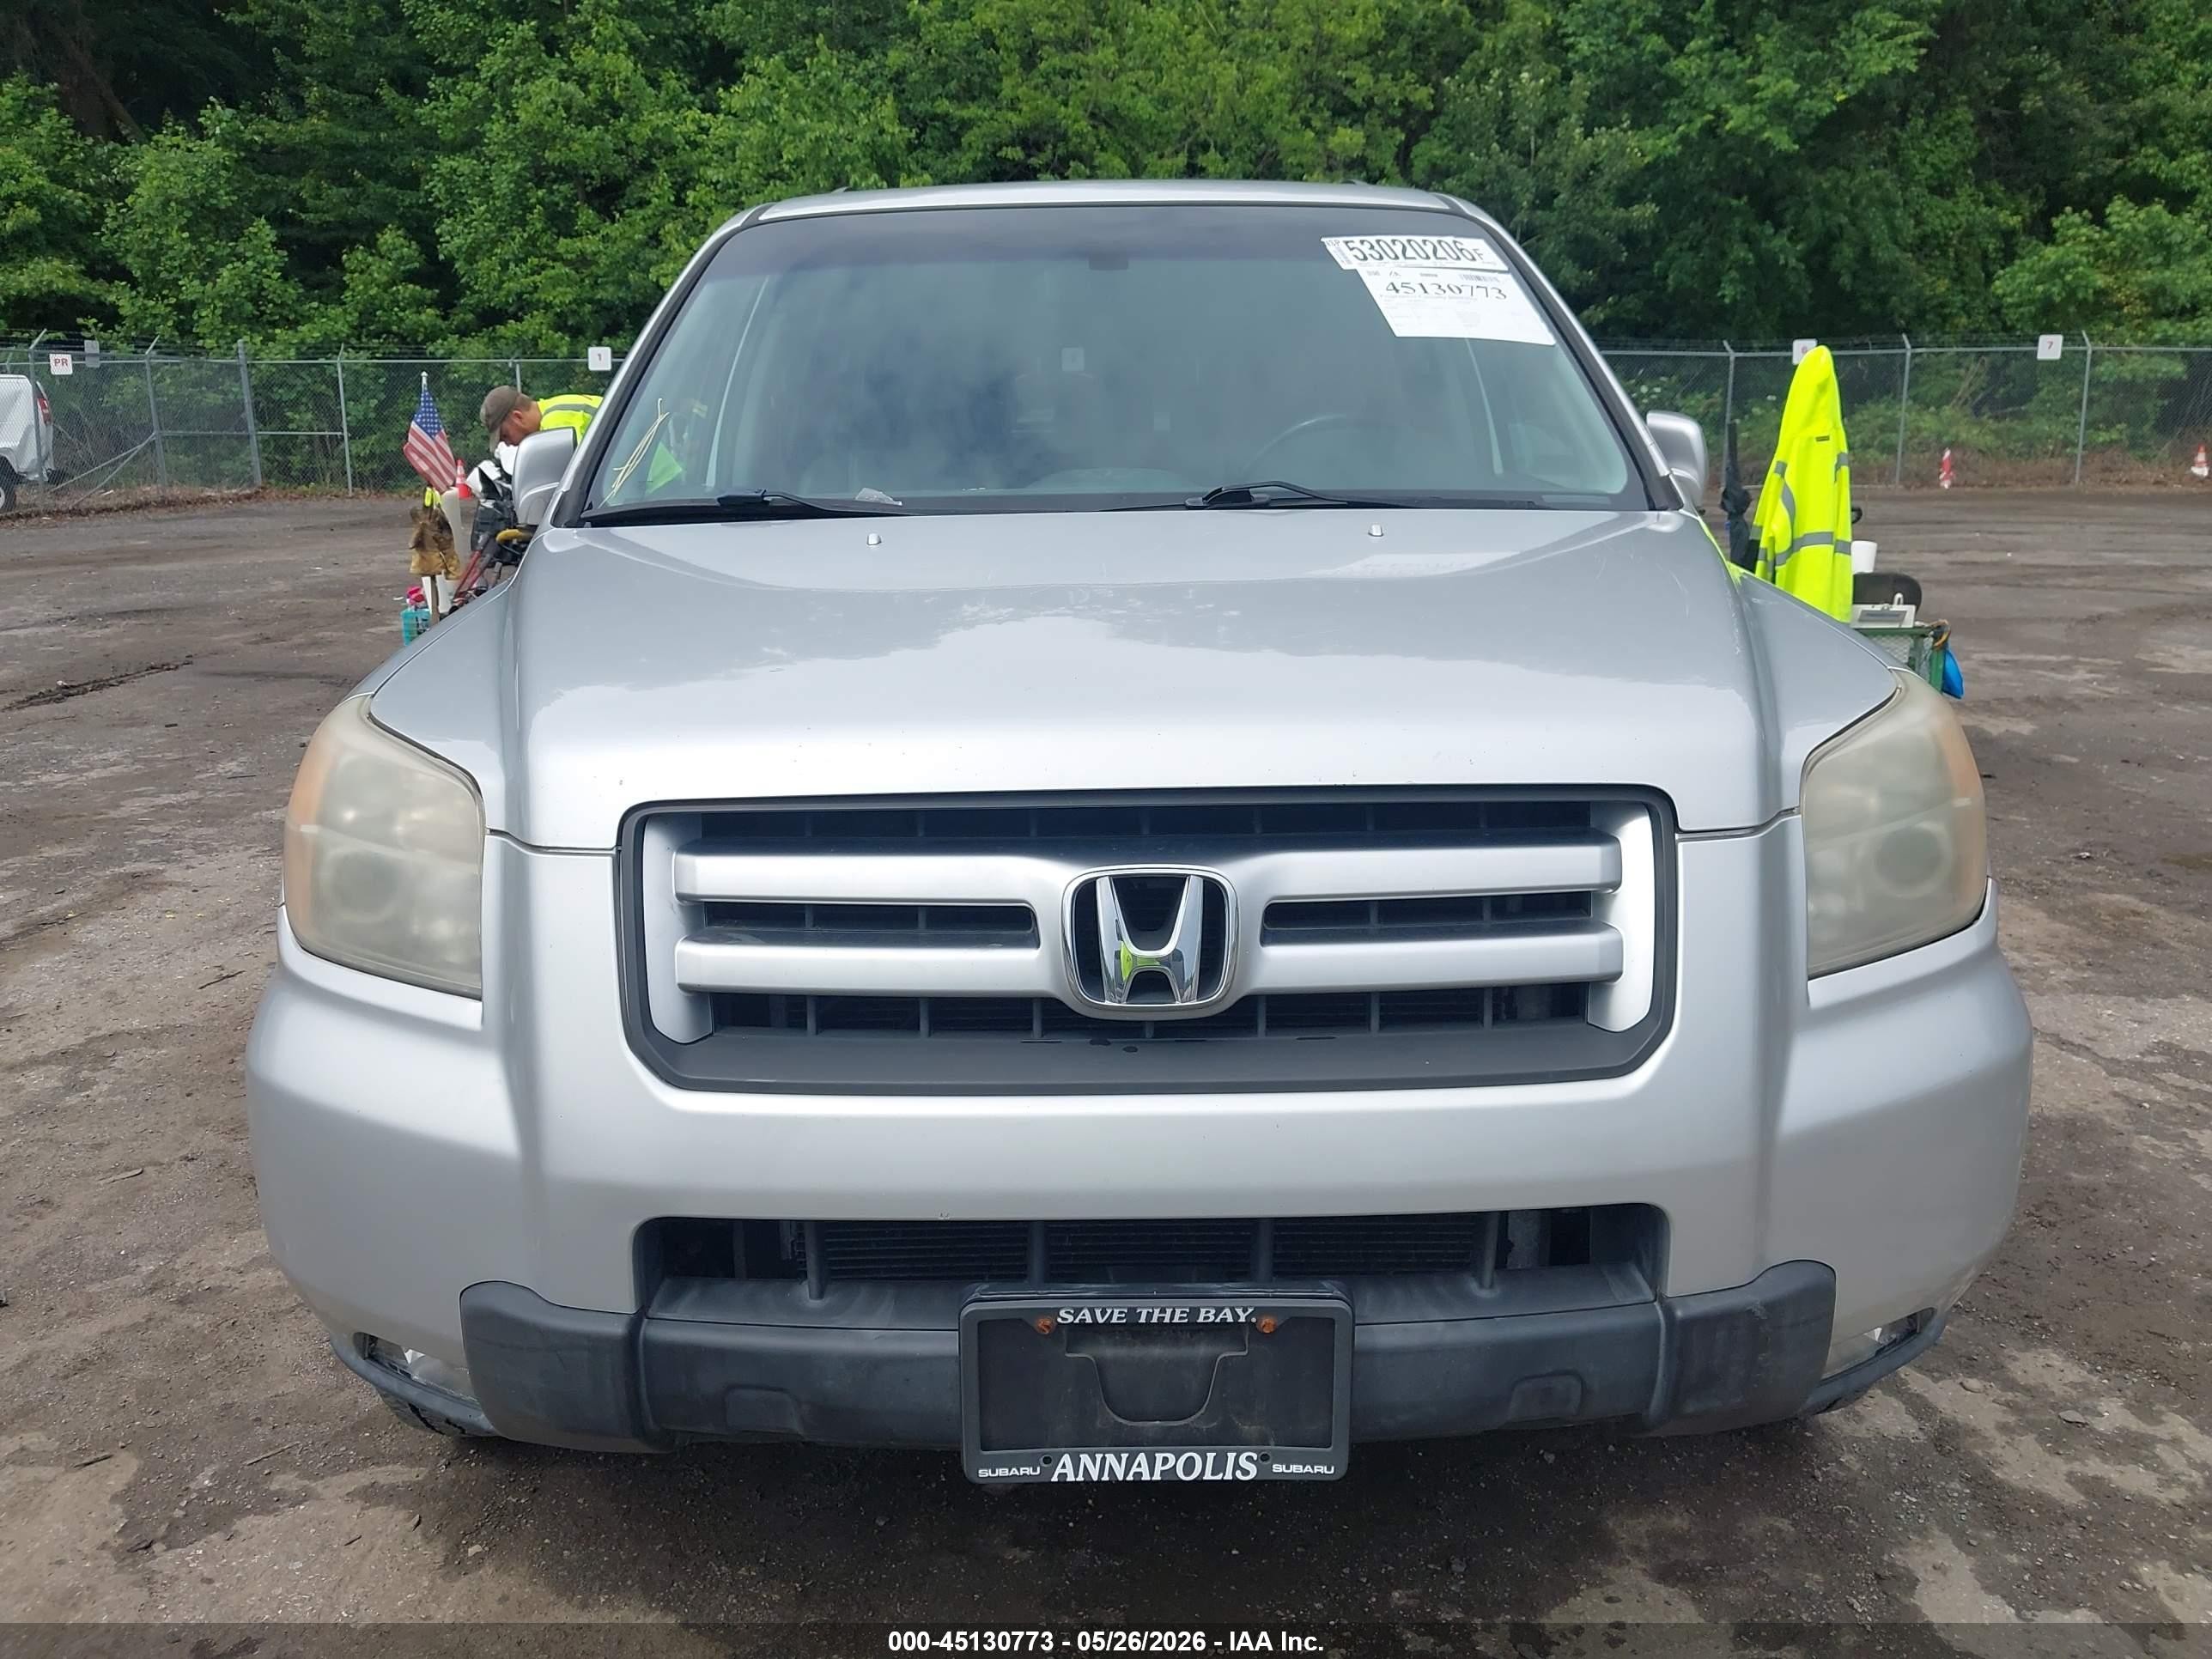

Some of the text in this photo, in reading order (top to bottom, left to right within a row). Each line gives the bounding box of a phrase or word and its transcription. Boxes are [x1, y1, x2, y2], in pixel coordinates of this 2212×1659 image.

[1342, 239, 1476, 261] 53020206
[1386, 282, 1507, 301] 45130773
[2046, 340, 2054, 350] 7
[54, 358, 69, 367] PR
[1056, 1307, 1257, 1324] SAVE THE BAY.
[978, 1466, 1041, 1478] SUBARU
[1050, 1451, 1258, 1482] ANNAPOLIS
[1272, 1463, 1334, 1474] SUBARU
